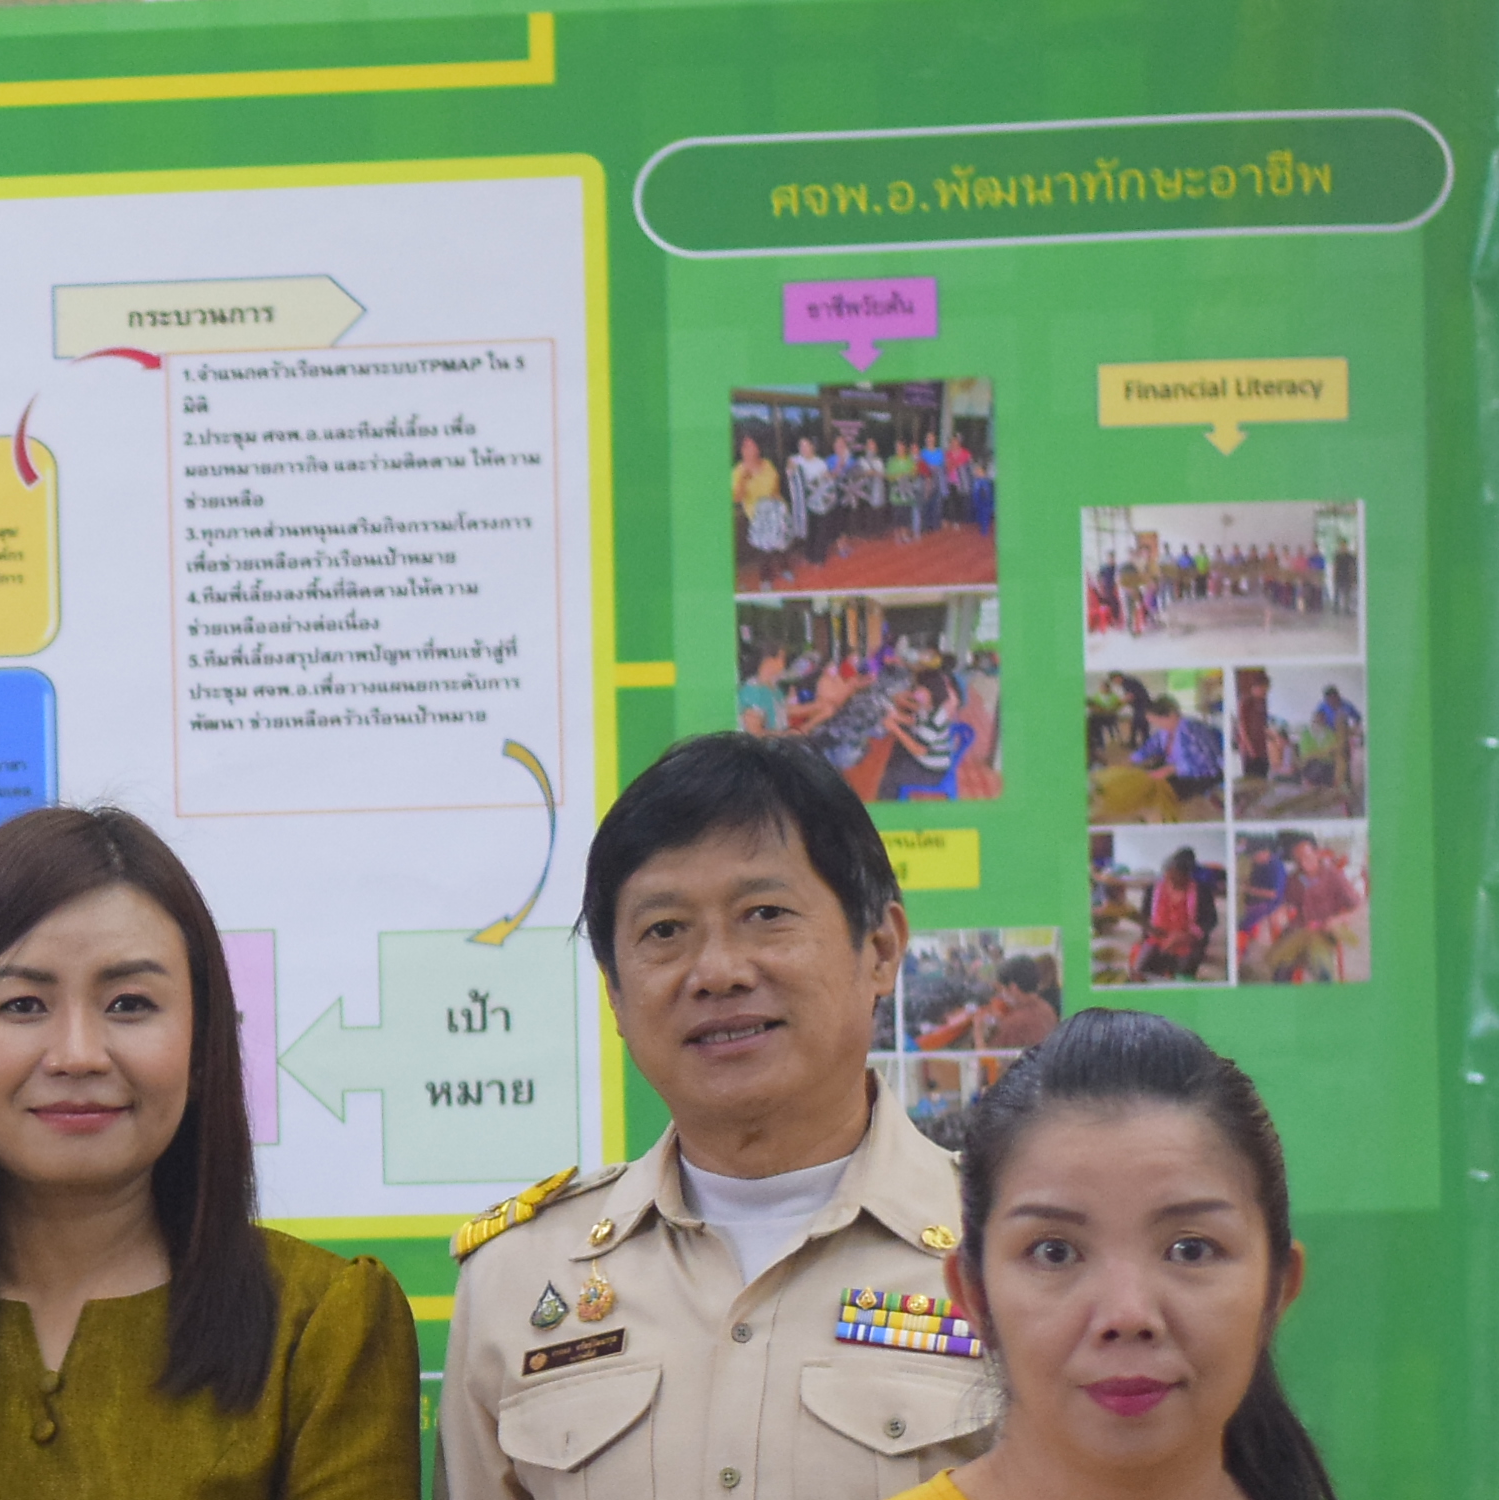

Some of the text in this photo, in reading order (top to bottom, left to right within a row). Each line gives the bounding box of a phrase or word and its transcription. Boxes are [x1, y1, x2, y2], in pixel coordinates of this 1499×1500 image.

[769, 150, 1334, 221] ศจพ.อ.พัฒนาทักษะอาชีพ
[127, 303, 276, 330] กระบวนการ
[1124, 373, 1324, 403] Financial Literacy
[446, 988, 512, 1034] เป้า
[424, 1077, 536, 1108] หมาย
